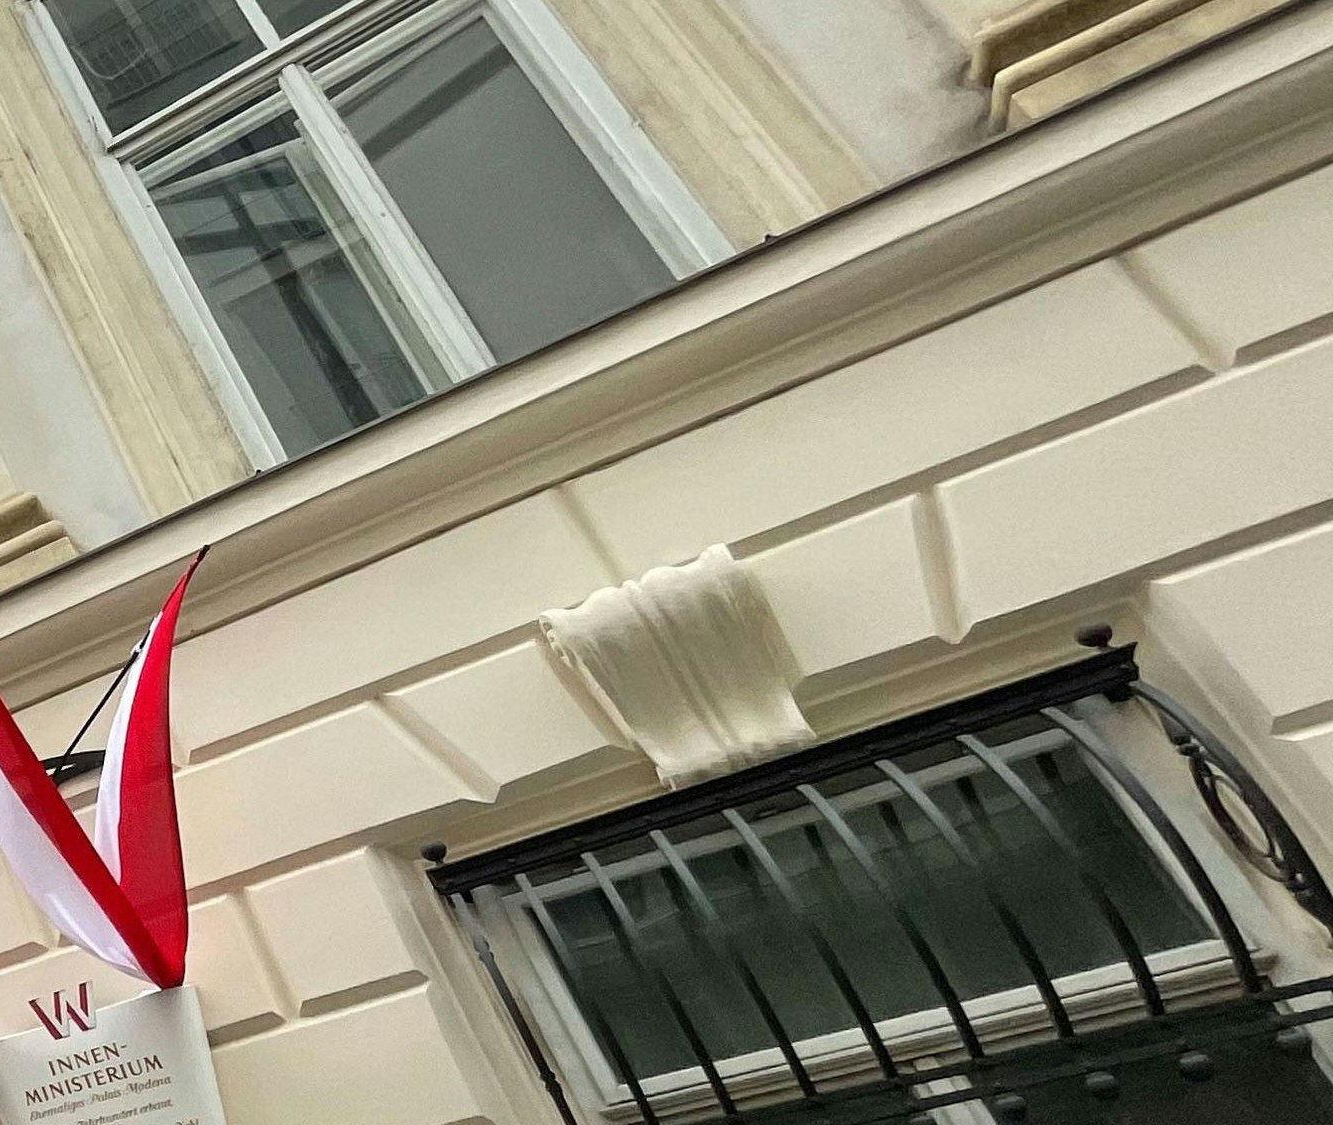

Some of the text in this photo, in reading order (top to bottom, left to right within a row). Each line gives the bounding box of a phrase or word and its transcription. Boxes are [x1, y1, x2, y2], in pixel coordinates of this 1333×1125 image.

[48, 1042, 128, 1076] INNEN-
[25, 1054, 164, 1107] MINISTERIUM
[89, 1090, 121, 1104] Palais
[125, 1076, 172, 1094] Modena
